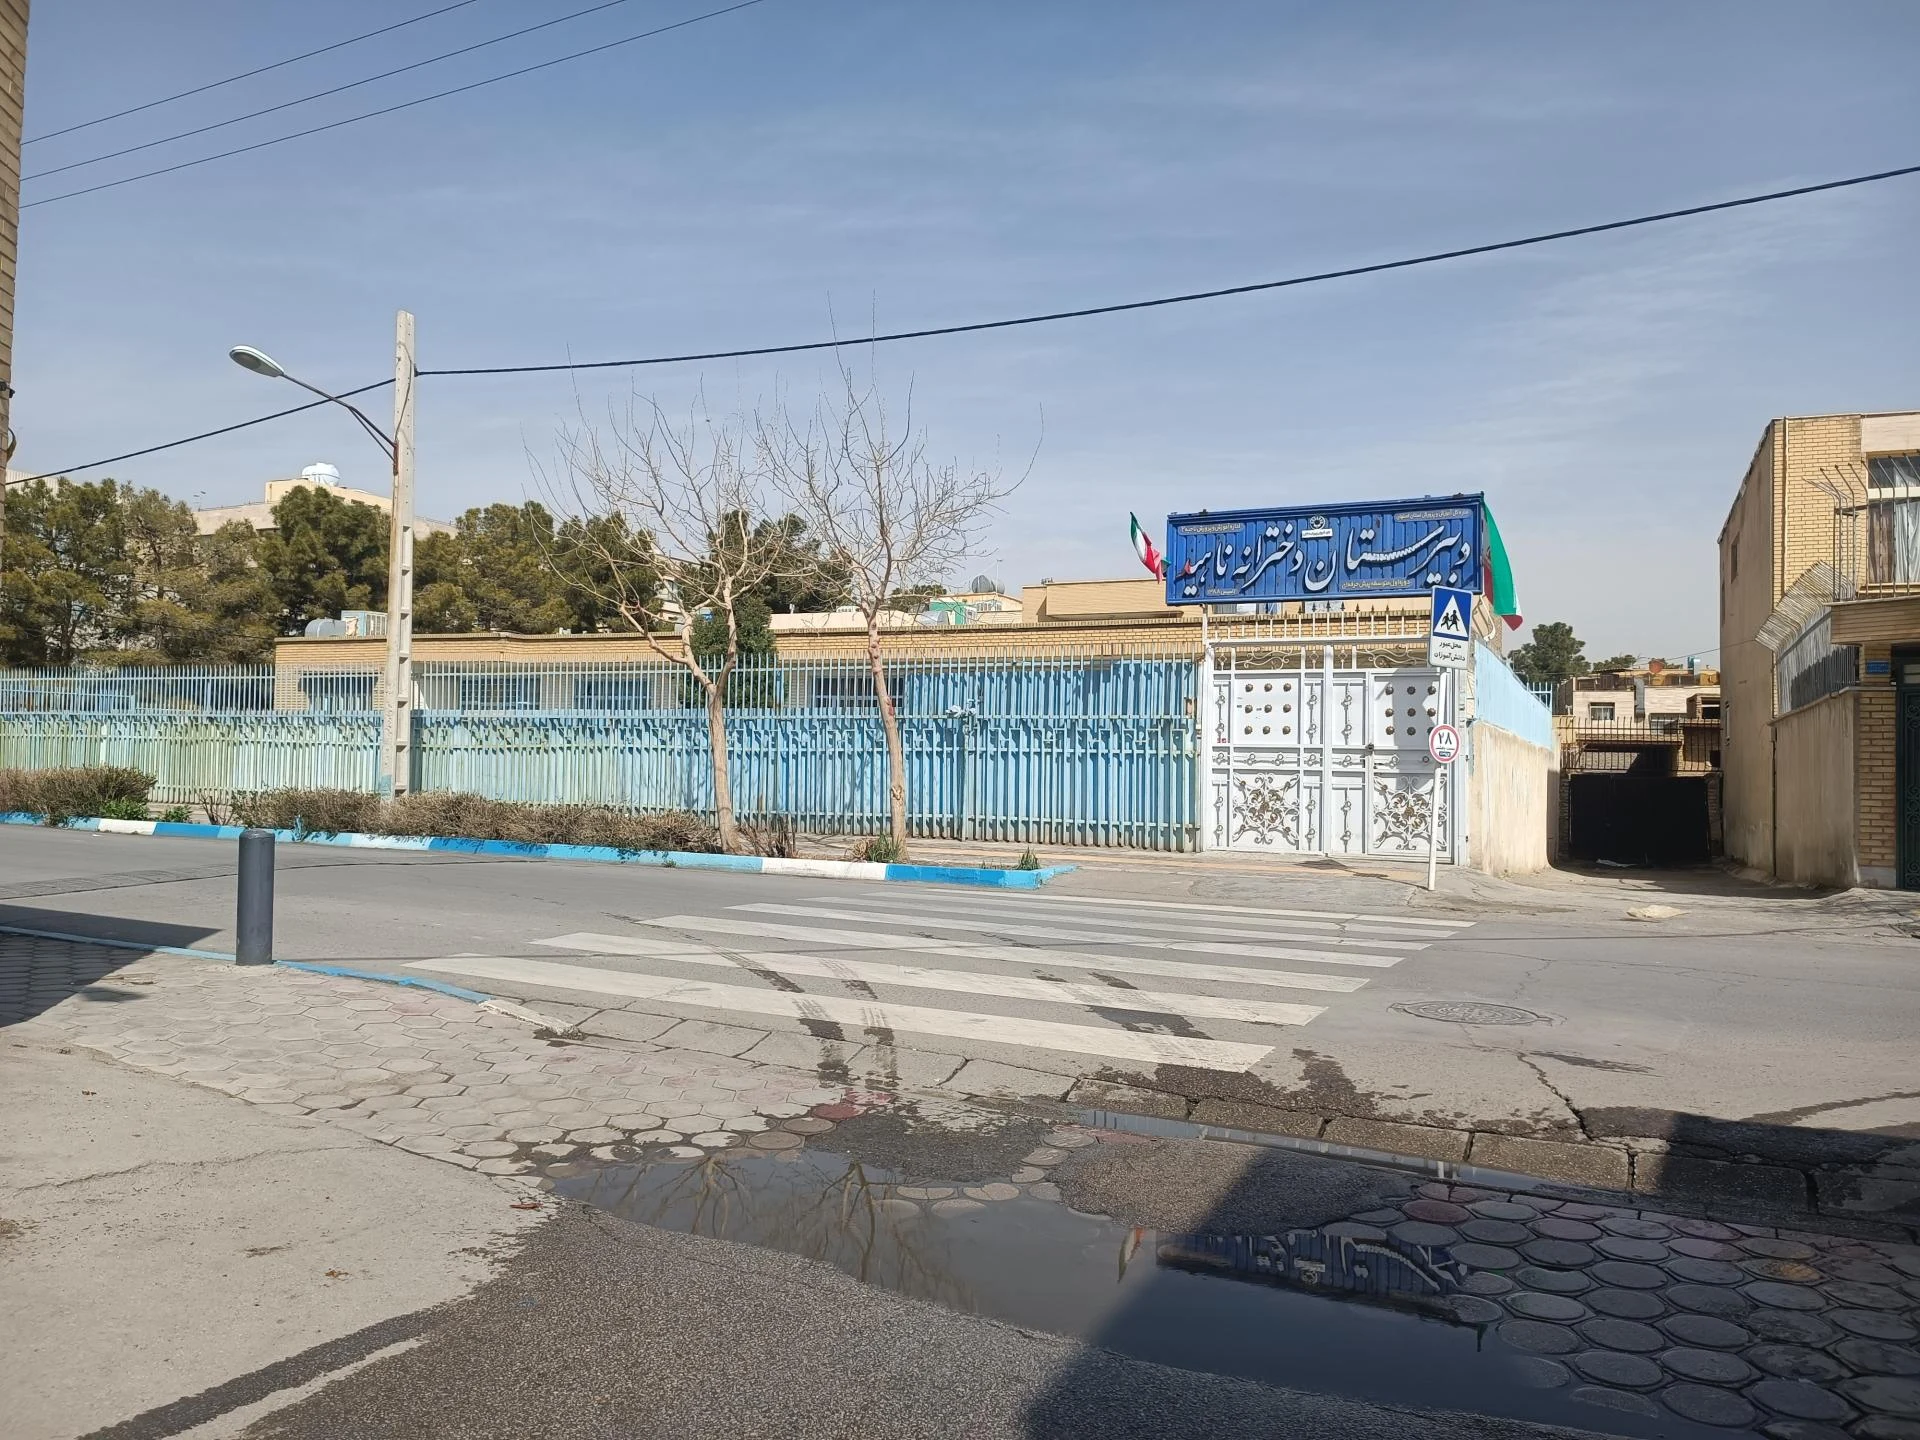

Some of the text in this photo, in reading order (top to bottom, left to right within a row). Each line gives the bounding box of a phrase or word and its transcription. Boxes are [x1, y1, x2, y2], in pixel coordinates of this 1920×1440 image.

[1176, 523, 1471, 596] دبیرستان دخترانه ناهید
